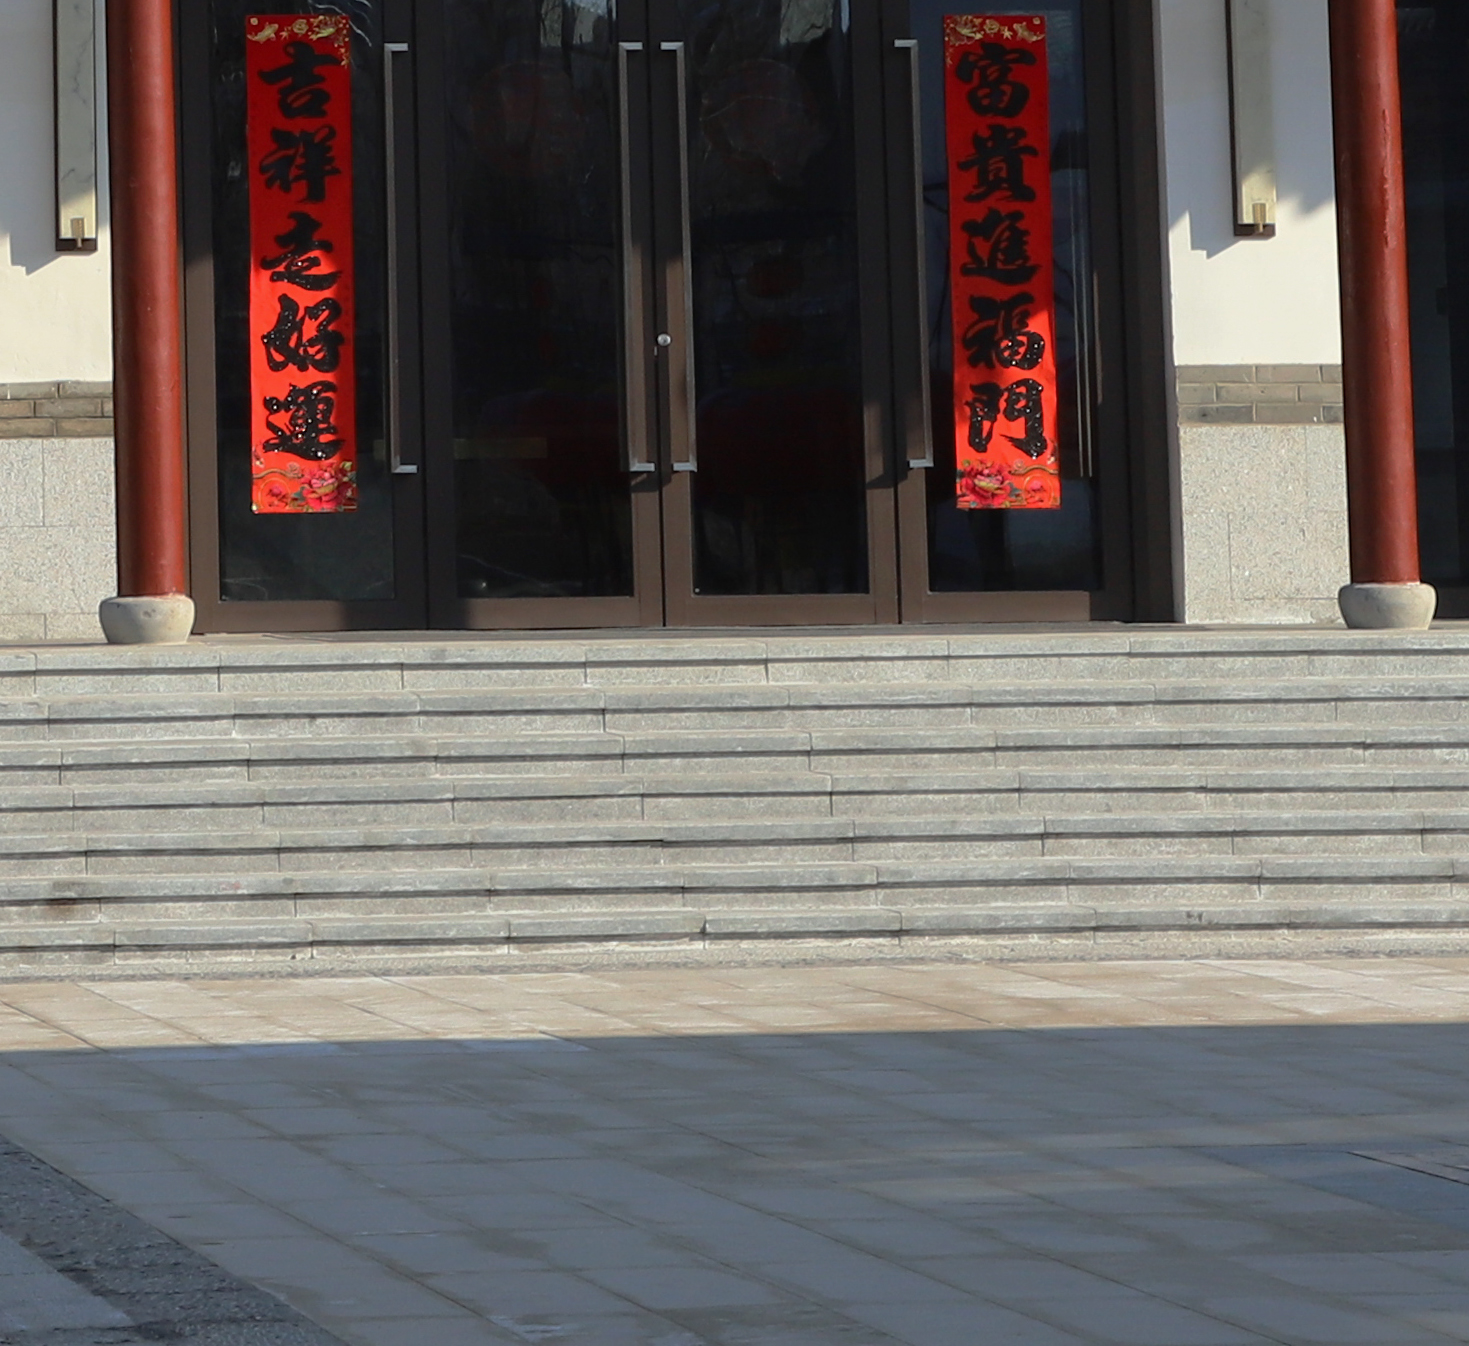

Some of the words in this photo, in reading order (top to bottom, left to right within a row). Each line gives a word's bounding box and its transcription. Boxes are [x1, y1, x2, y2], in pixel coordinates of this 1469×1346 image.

[956, 41, 1046, 460] 富貴進福門
